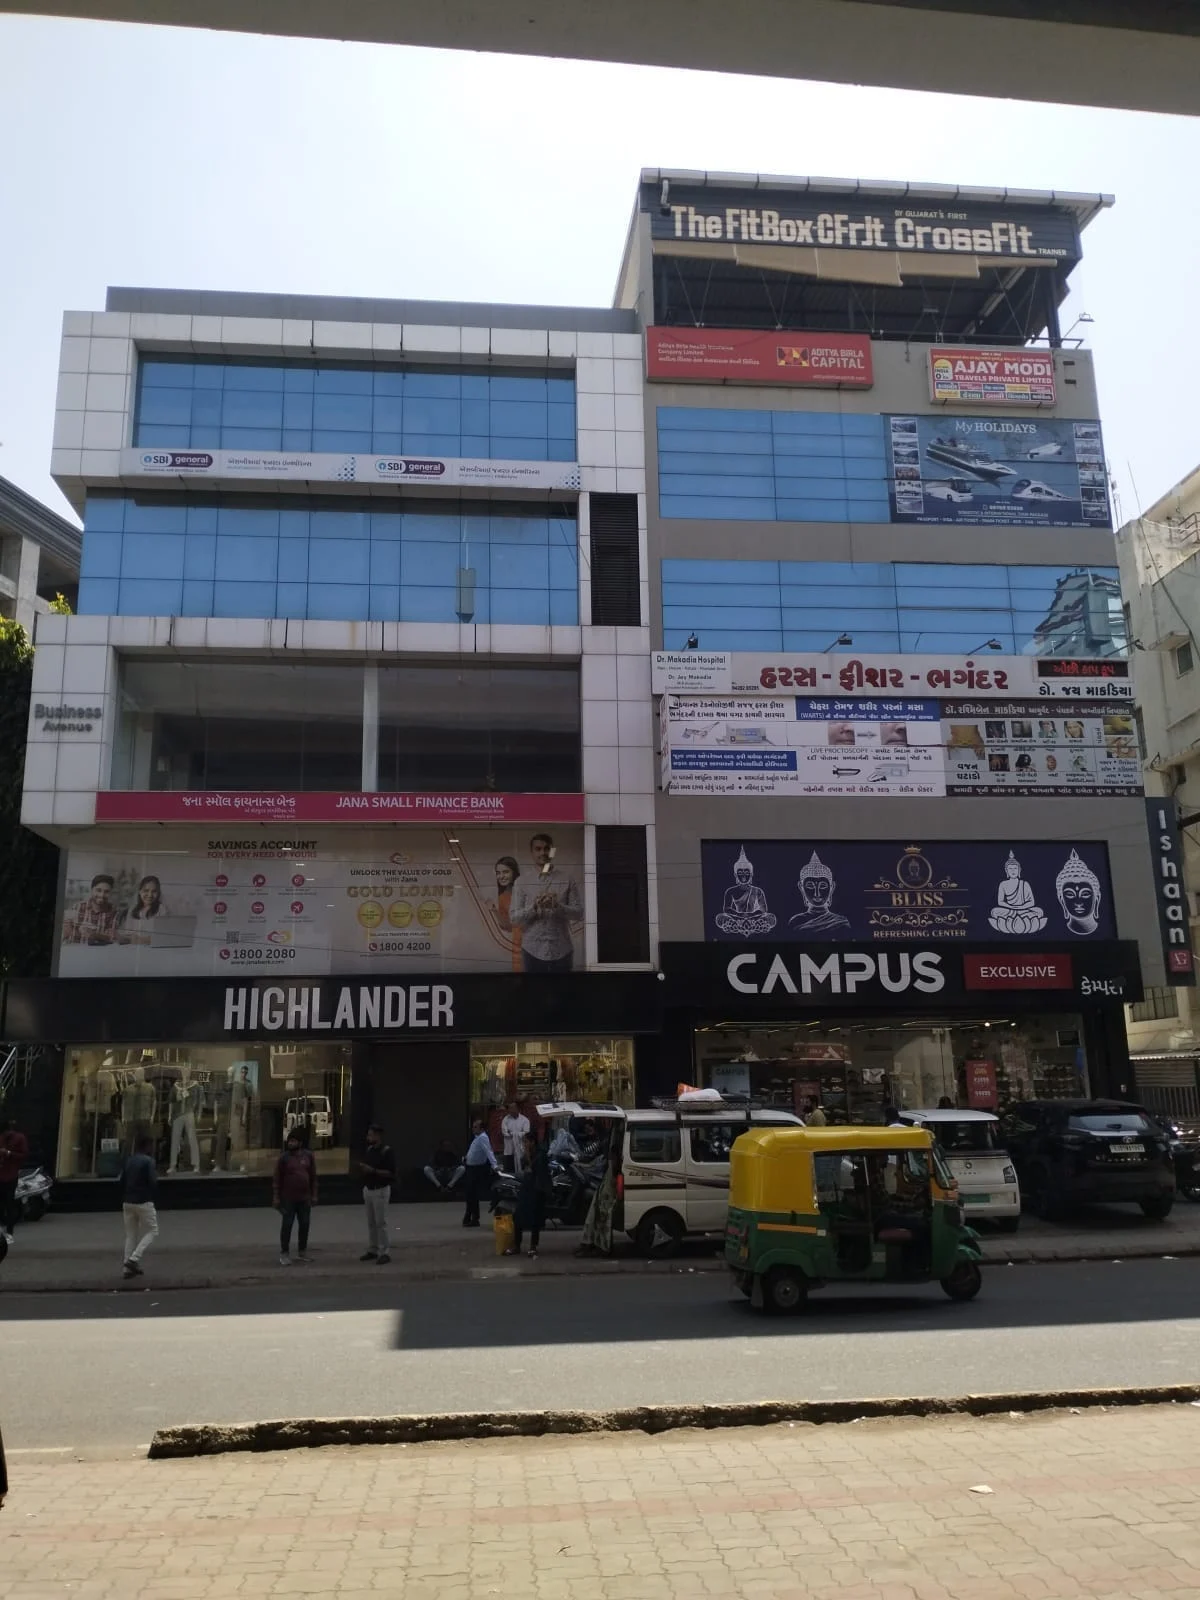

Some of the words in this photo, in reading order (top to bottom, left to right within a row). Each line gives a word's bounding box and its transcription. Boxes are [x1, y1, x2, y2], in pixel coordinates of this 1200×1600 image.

[947, 211, 968, 221] FIRST
[1038, 248, 1067, 256] TRAINER
[811, 347, 839, 357] ADITYA
[840, 349, 864, 358] BIRLA
[811, 357, 865, 369] CAPITAL
[955, 361, 998, 374] AJAY
[1004, 362, 1051, 376] MODI
[954, 374, 987, 382] TRAVELS
[988, 375, 1020, 383] PRIVATE
[1021, 376, 1052, 384] LIMITED
[974, 422, 1037, 434] HOLIDAYS
[153, 455, 169, 464] SBI
[174, 455, 208, 466] general
[387, 462, 403, 470] SBI
[408, 463, 441, 473] general
[657, 655, 667, 664] Dr.
[667, 655, 697, 664] Makadia
[697, 655, 726, 665] Hospital
[759, 666, 816, 688] હરસ
[839, 660, 904, 691] ફીશર
[927, 661, 1008, 690] ભગંદર
[1061, 687, 1080, 696] જય
[1086, 683, 1132, 696] માકડિયા
[42, 720, 93, 732] Avenue
[956, 772, 980, 781] ઘટાડો
[182, 796, 202, 806] જના
[205, 794, 231, 806] સ્મોલ
[234, 796, 275, 808] ફાયનાન્સ
[276, 794, 296, 806] બેન્ક
[336, 797, 369, 808] JANA
[372, 796, 413, 808] SMALL
[415, 796, 467, 808] FINANCE
[470, 796, 504, 808] BANK
[207, 841, 257, 850] SAVINGS
[259, 841, 318, 850] ACCOUNT
[1158, 809, 1185, 944] Ishaan
[347, 886, 393, 898] GOLD
[399, 885, 454, 897] LOANS
[890, 891, 944, 907] BLISS
[873, 930, 930, 938] REFRESHING
[931, 929, 967, 938] CENTER
[379, 942, 404, 951] 1800
[406, 942, 431, 951] 4200
[233, 949, 263, 960] 1800
[265, 949, 296, 959] 2080
[726, 951, 945, 993] CAMPUS
[980, 966, 1057, 979] EXCLUSIVE
[223, 985, 454, 1030] HIGHLANDER
